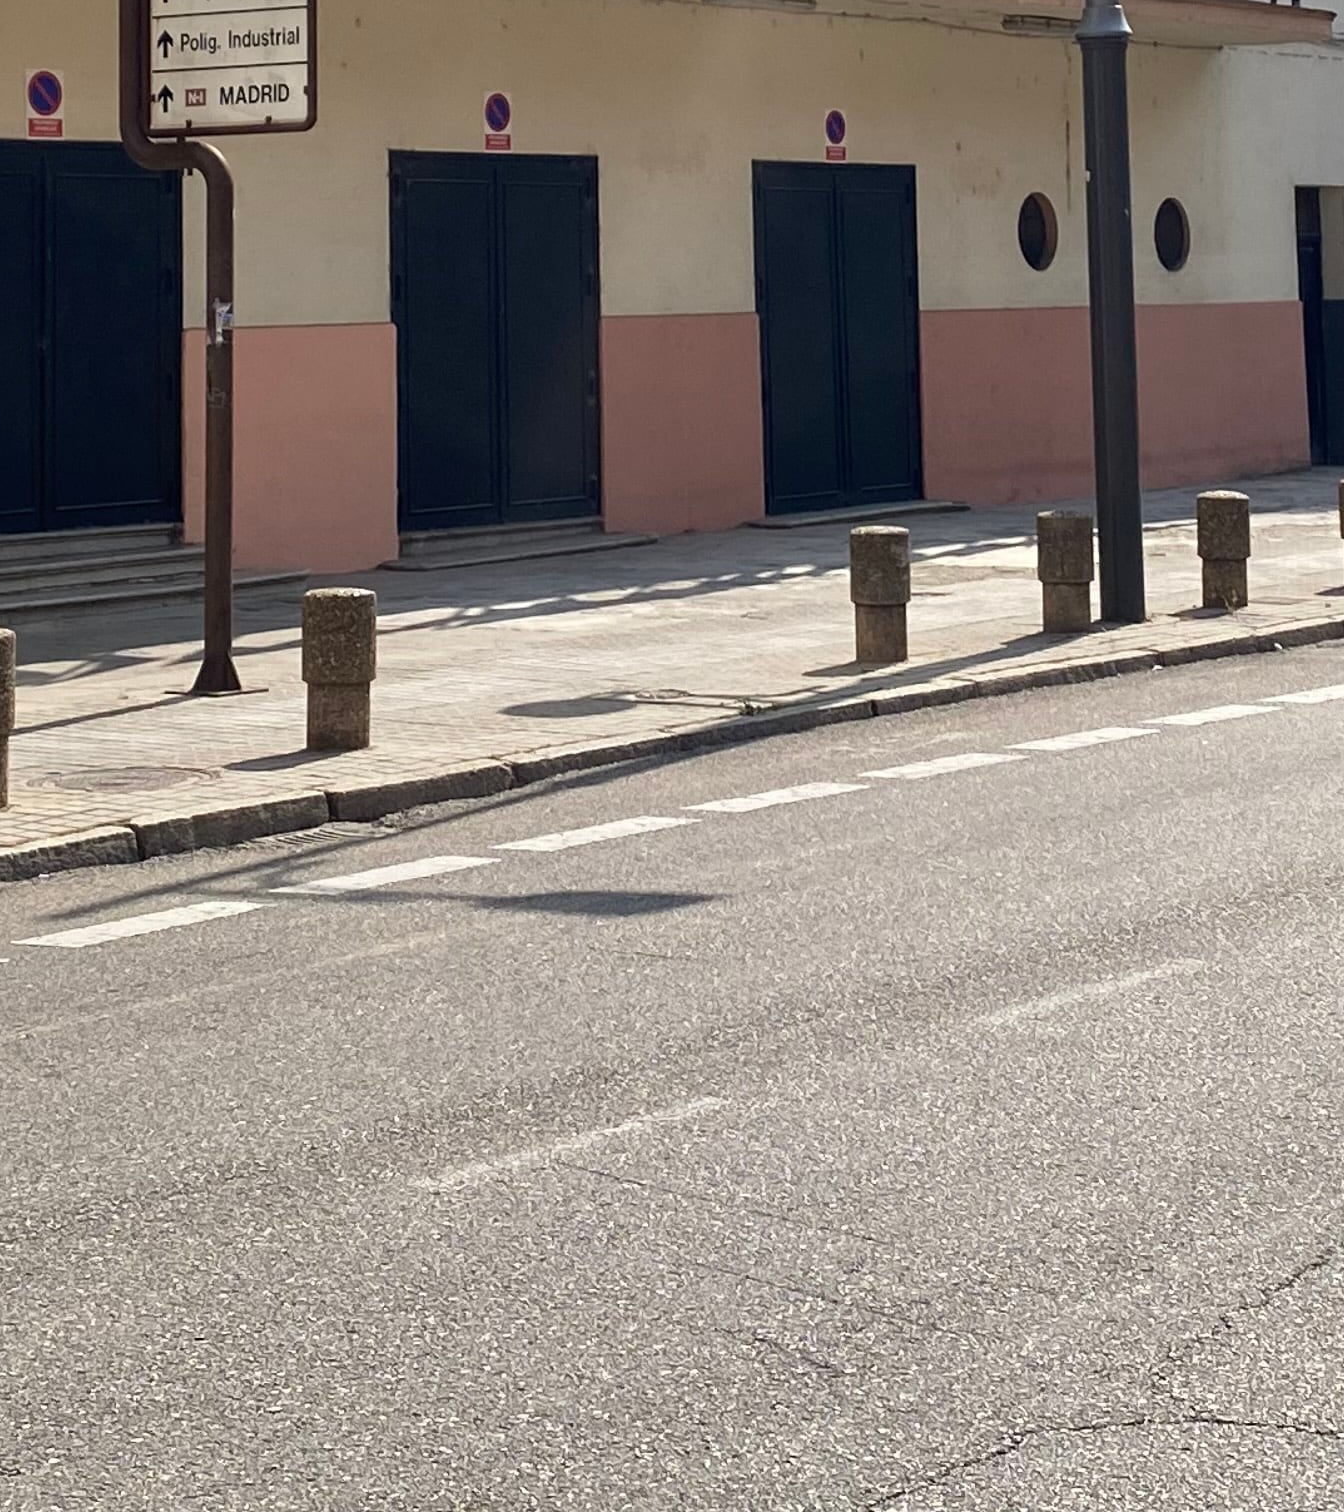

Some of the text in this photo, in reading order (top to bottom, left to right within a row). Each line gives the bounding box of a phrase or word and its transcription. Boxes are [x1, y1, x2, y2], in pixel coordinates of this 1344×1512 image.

[180, 26, 300, 54] Polig. Industrial
[219, 83, 290, 105] MADRID
